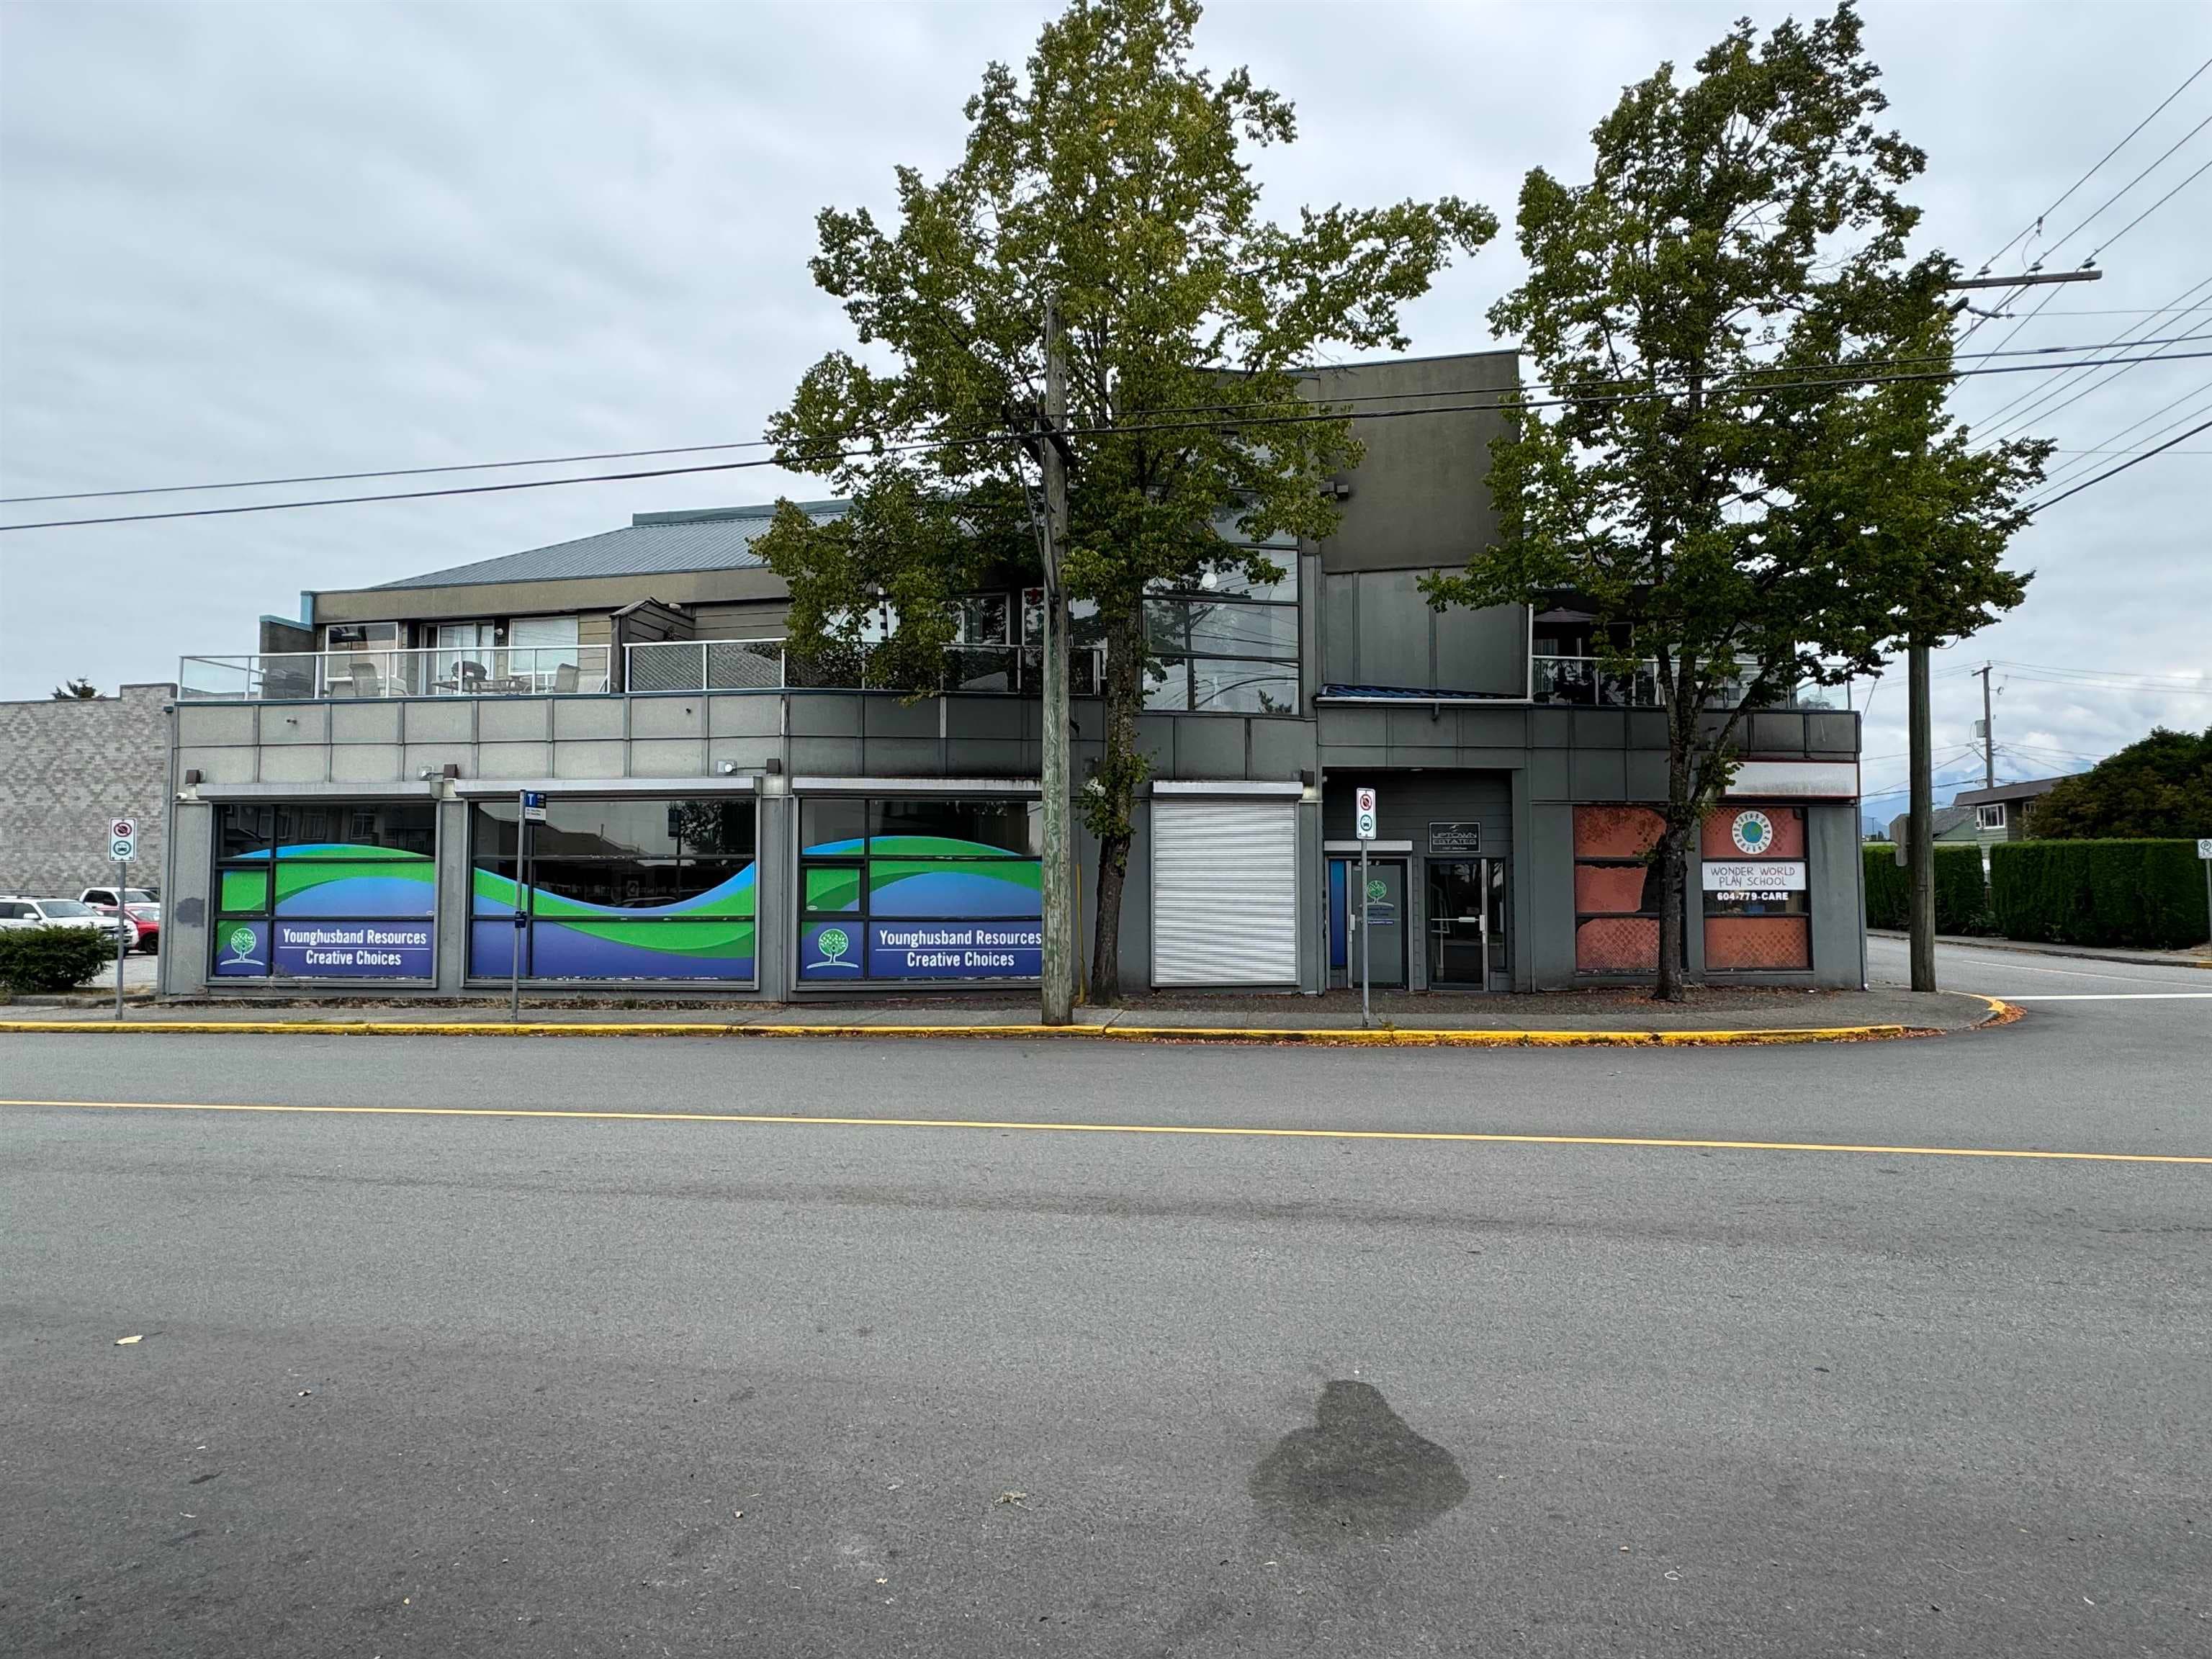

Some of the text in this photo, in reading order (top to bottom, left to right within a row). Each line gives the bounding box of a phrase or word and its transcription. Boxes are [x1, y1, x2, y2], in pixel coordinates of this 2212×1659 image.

[1711, 866, 1795, 876] WONDER WORLD
[1719, 876, 1786, 887] PLAY SCHOOL
[1717, 892, 1789, 901] 604-779-CARE
[283, 929, 427, 946] Younghusband Resources
[879, 930, 1042, 948] Younghusband Resources
[306, 950, 402, 966] Creative Choices
[907, 951, 1015, 967] Creative Choices
